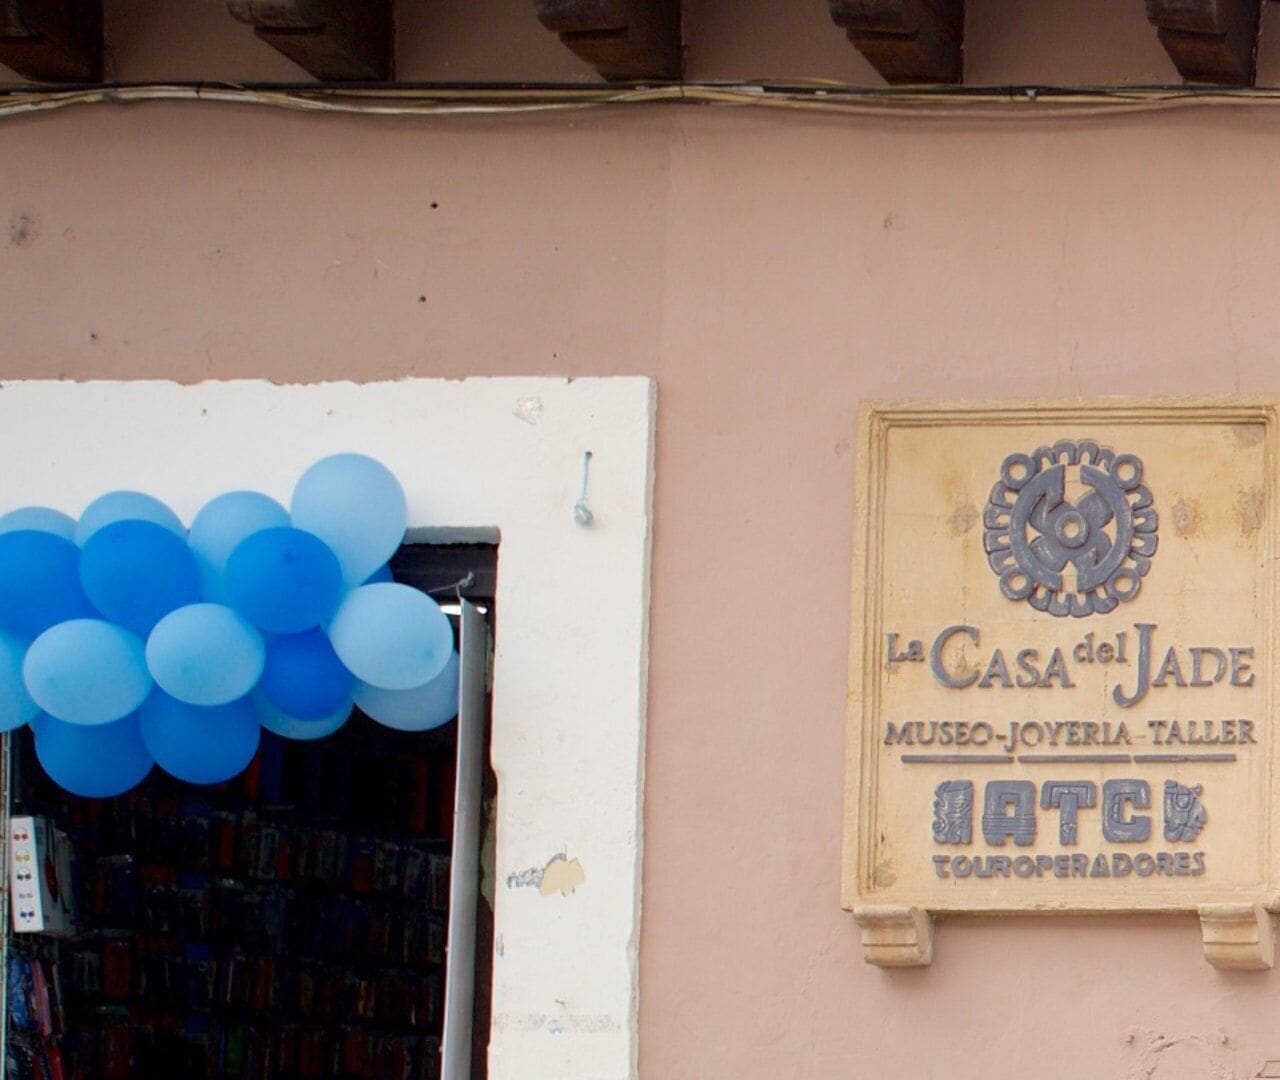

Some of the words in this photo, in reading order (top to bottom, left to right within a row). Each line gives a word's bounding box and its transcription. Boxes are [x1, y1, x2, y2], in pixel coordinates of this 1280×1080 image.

[886, 631, 926, 663] La
[1073, 631, 1128, 664] del
[931, 851, 1207, 881] TOUROPERADORES
